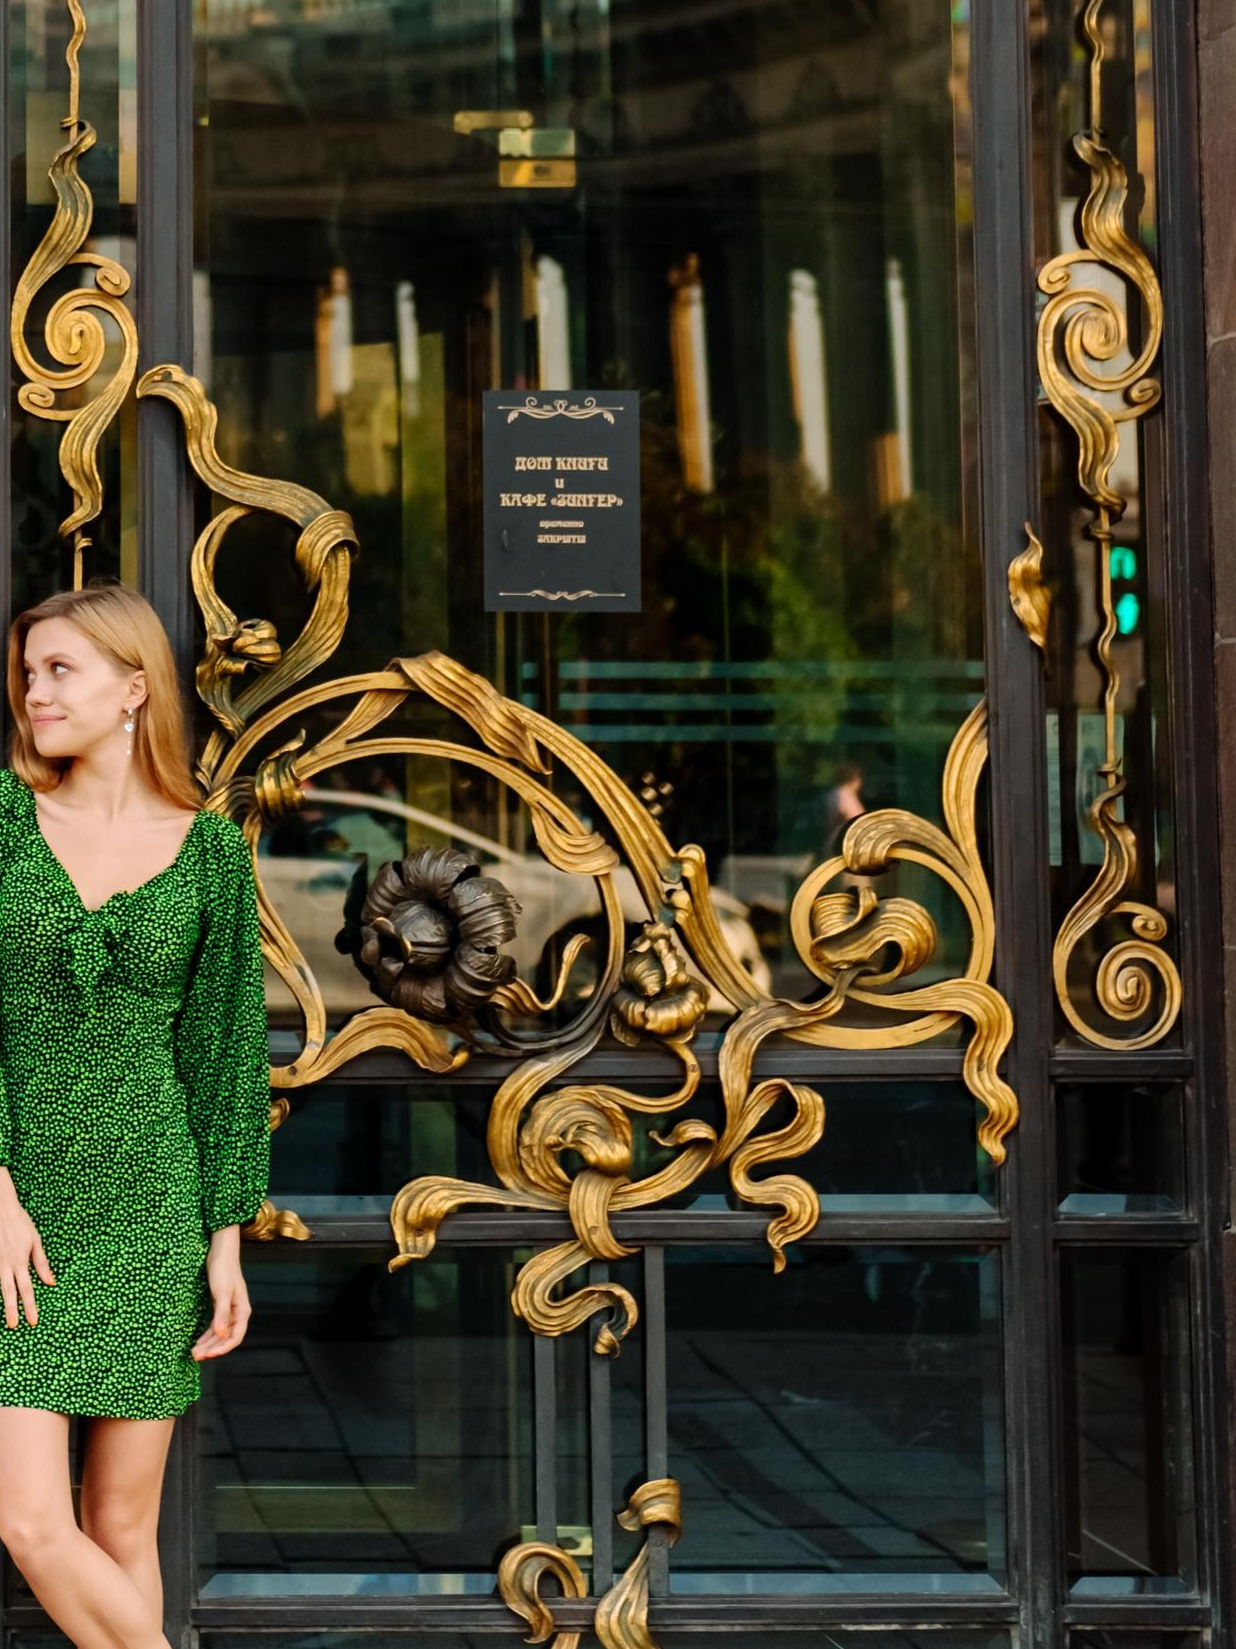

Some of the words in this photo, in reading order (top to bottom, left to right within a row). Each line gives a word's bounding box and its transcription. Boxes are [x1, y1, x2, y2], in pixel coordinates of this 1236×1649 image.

[515, 457, 552, 471] ДОМ
[556, 457, 608, 470] КНИГИ
[555, 479, 564, 488] и
[500, 494, 546, 507] КАФЕ
[550, 494, 623, 507] «ЗИНГЕР»
